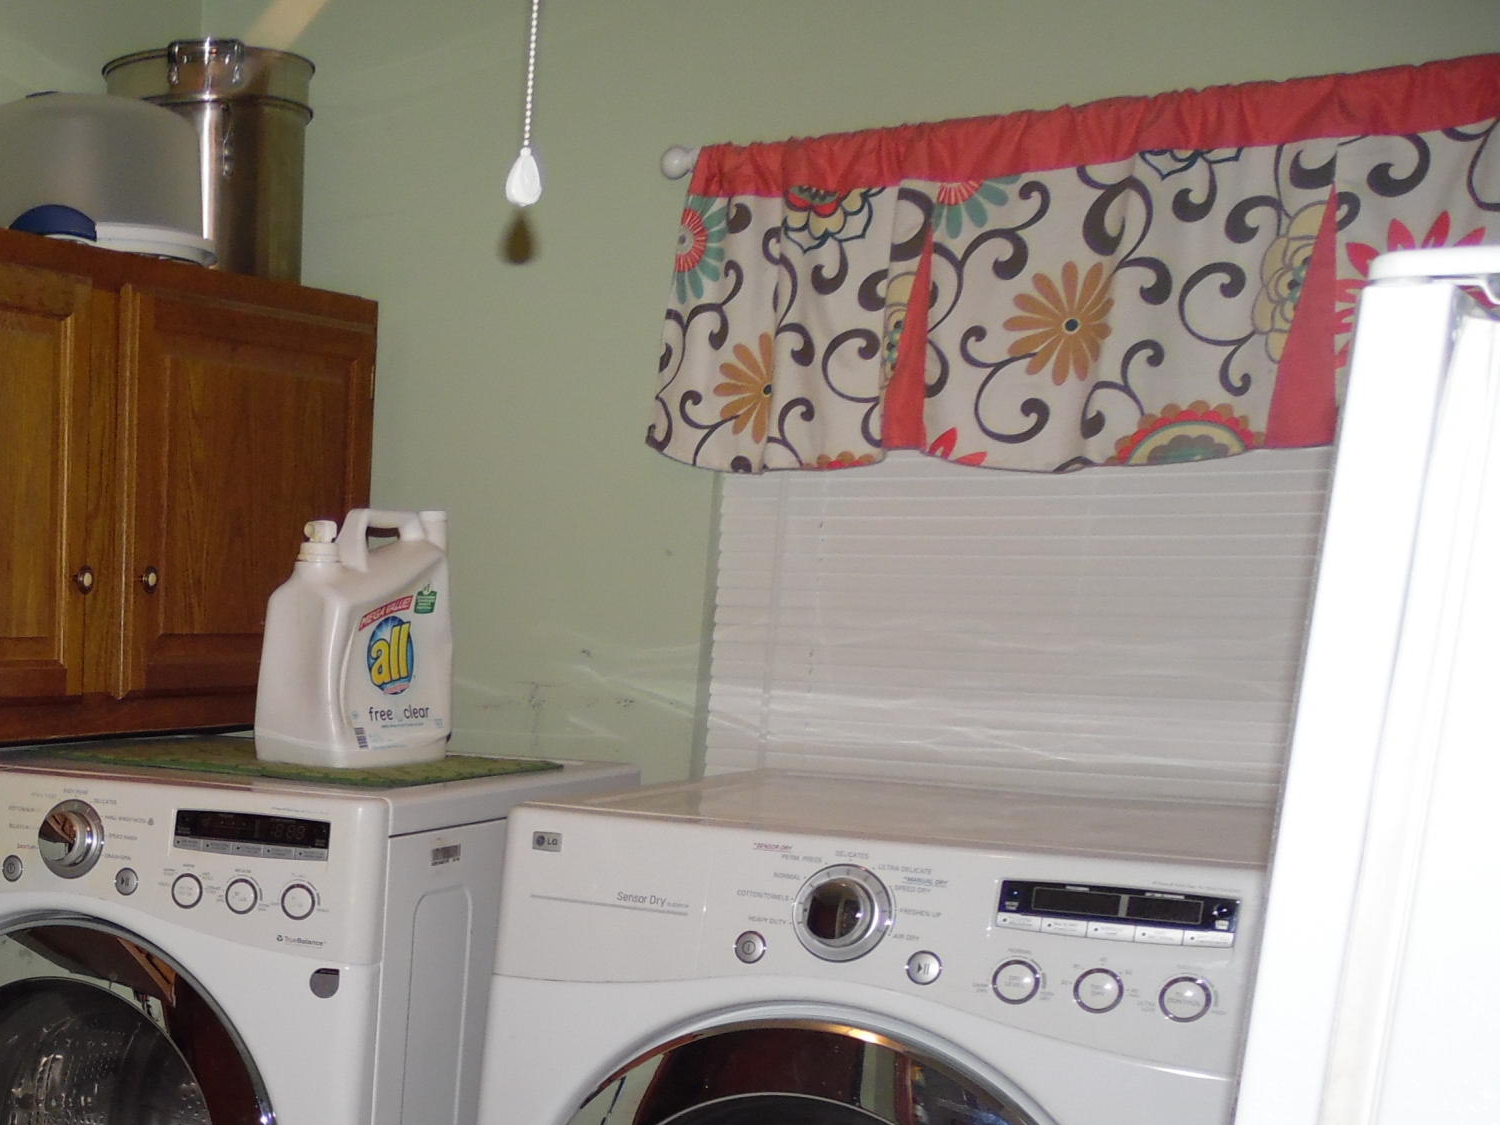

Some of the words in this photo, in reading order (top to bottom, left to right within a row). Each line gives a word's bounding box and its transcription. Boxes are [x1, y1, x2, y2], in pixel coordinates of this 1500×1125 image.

[370, 621, 411, 686] all
[368, 706, 393, 722] free
[403, 704, 429, 720] clear
[547, 837, 558, 846] LG
[616, 890, 647, 904] Sensor
[649, 894, 668, 908] Dry
